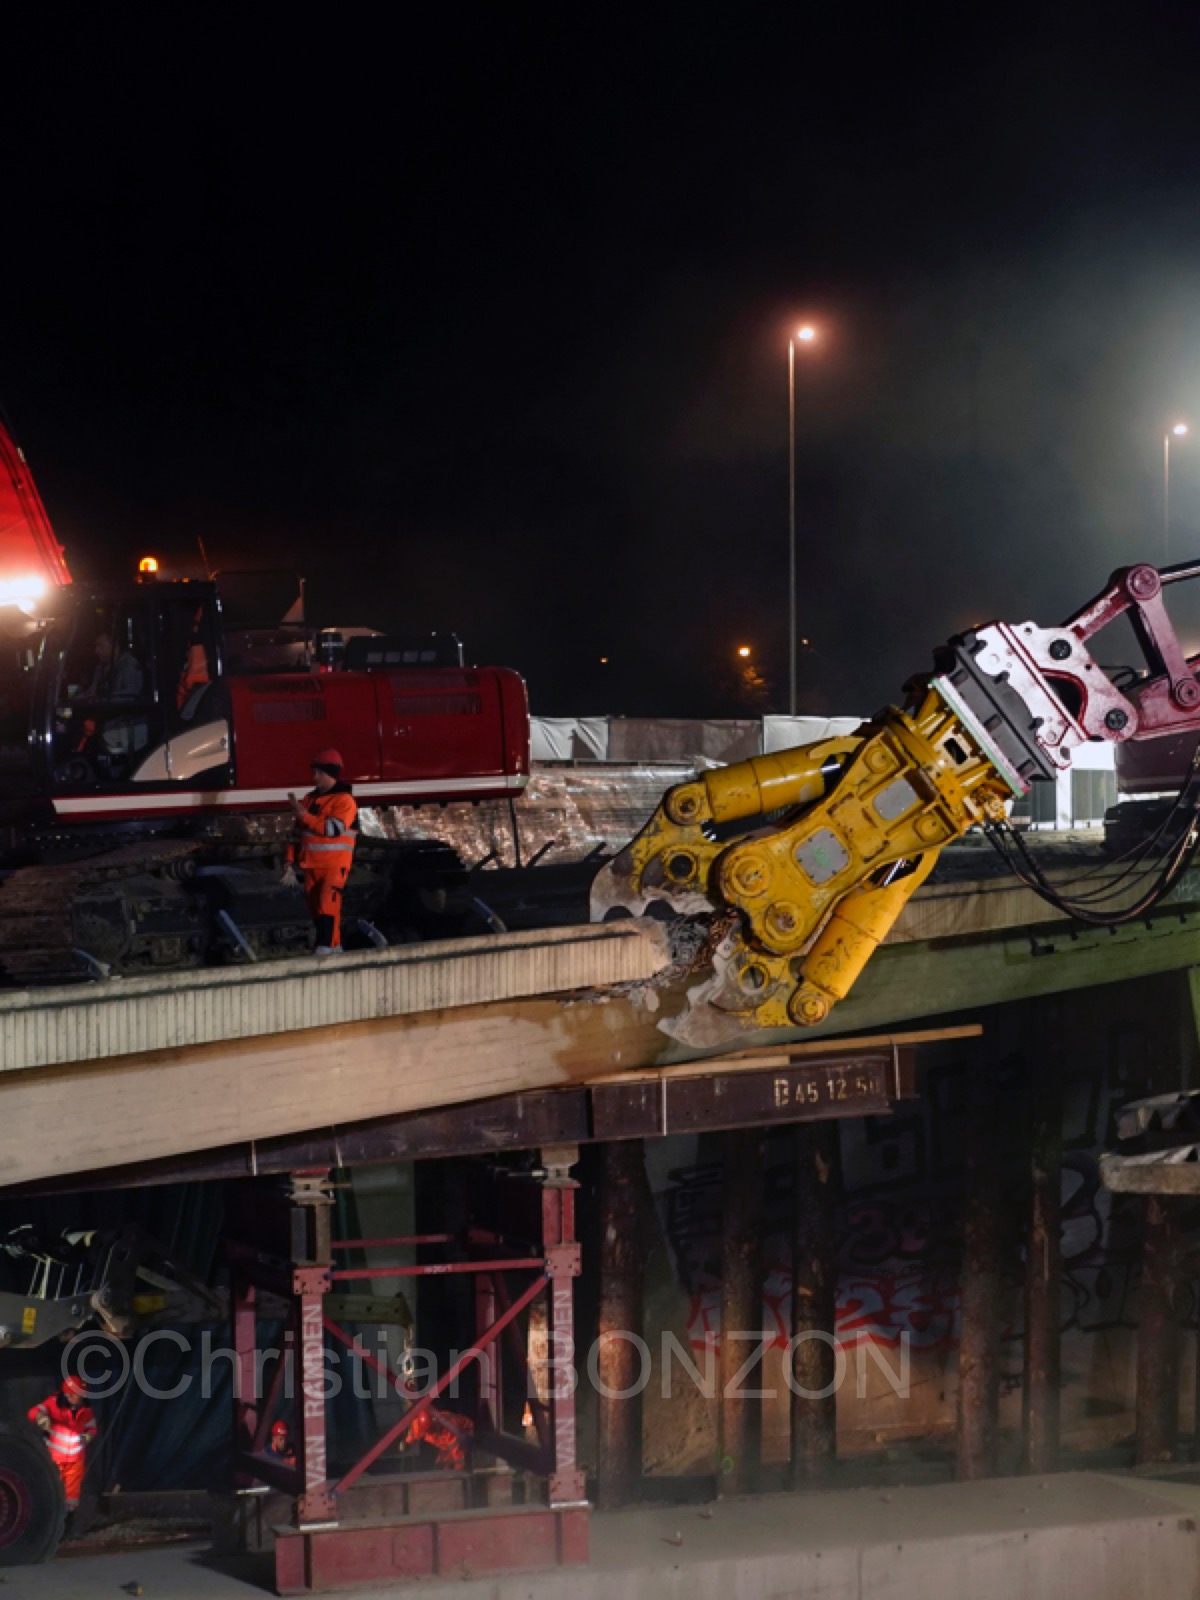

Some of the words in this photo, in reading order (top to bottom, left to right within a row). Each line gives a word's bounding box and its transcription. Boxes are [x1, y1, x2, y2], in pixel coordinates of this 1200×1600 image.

[827, 1079, 847, 1099] 12
[305, 1435, 327, 1488] VAN
[555, 1417, 575, 1468] VAN
